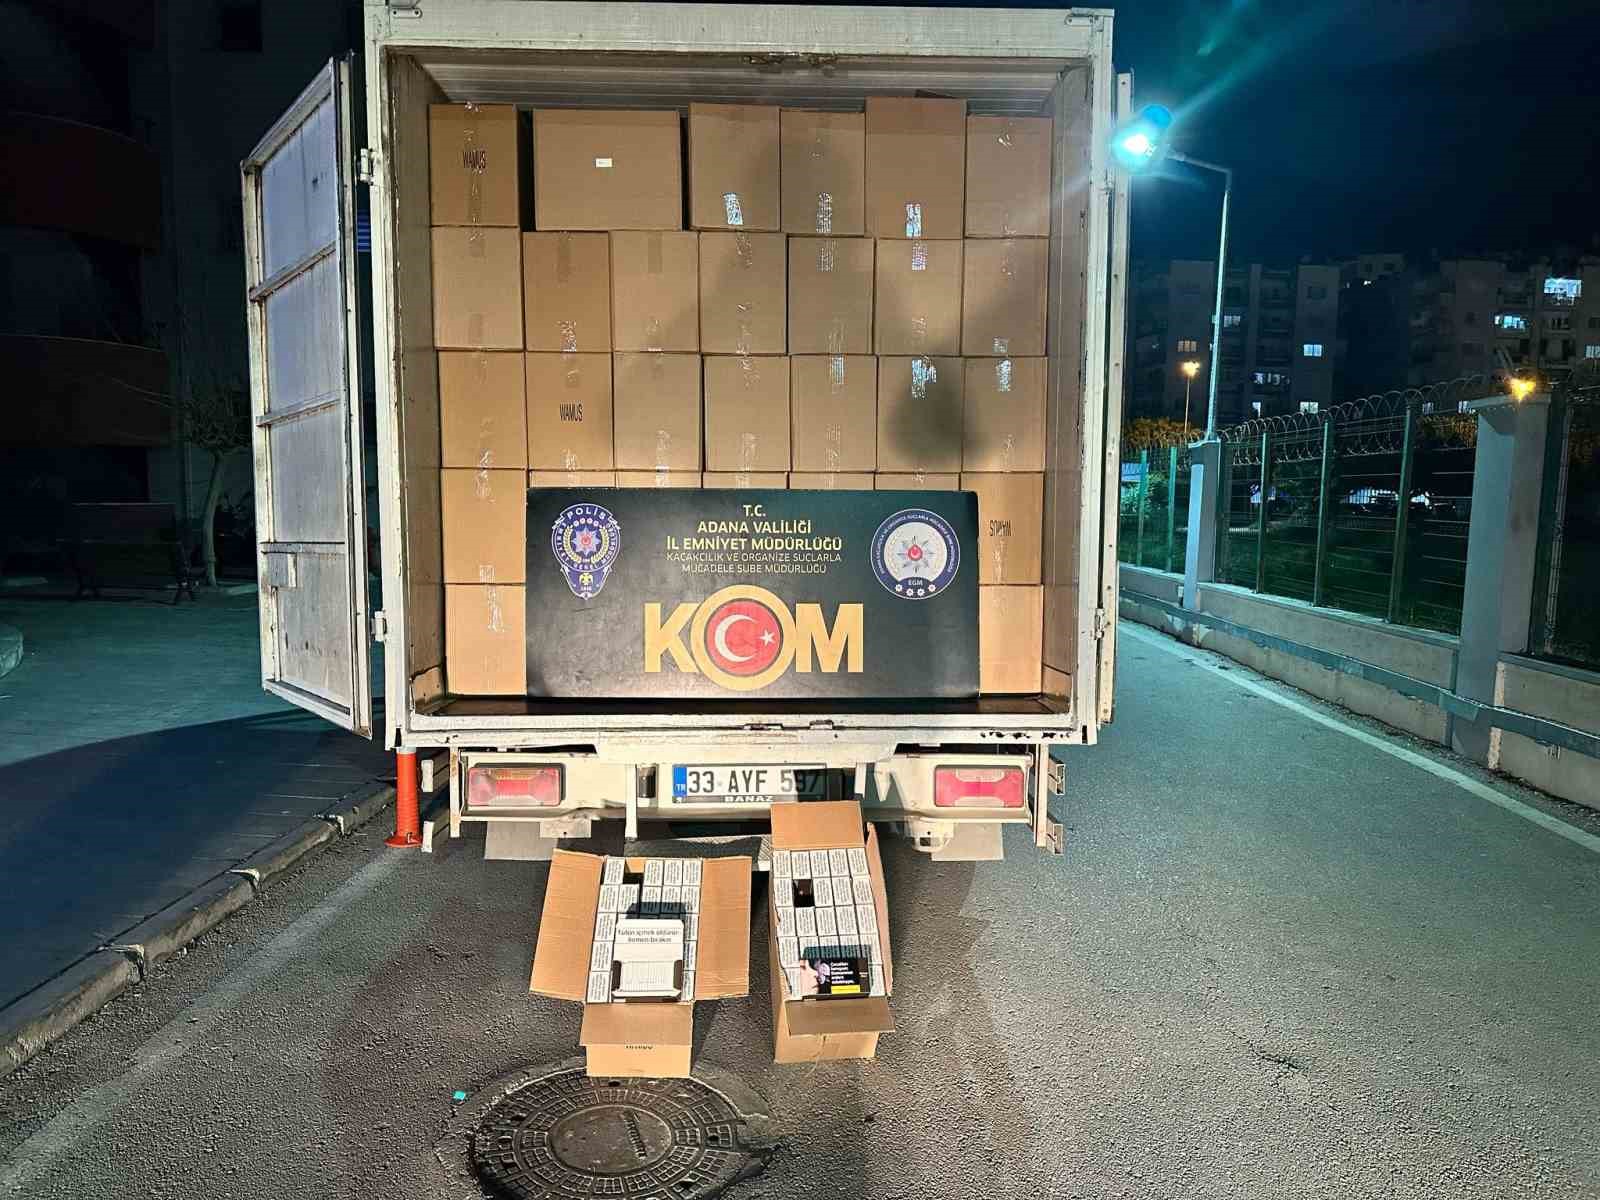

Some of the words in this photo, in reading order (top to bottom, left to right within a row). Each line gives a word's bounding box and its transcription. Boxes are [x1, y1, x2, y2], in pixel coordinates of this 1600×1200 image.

[559, 403, 583, 422] WAMUS
[743, 504, 767, 517] T.C.
[697, 520, 749, 534] ADANA
[753, 519, 812, 534] VALİLİĞİ
[666, 535, 679, 551] İL
[683, 535, 747, 551] EMNİYET
[751, 536, 842, 551] MÜDÜRLÜĞÜ
[726, 552, 739, 562] VE
[741, 551, 791, 562] ORGANİZE
[644, 584, 864, 692] KOM
[688, 770, 715, 794] 33
[727, 769, 768, 794] AYF
